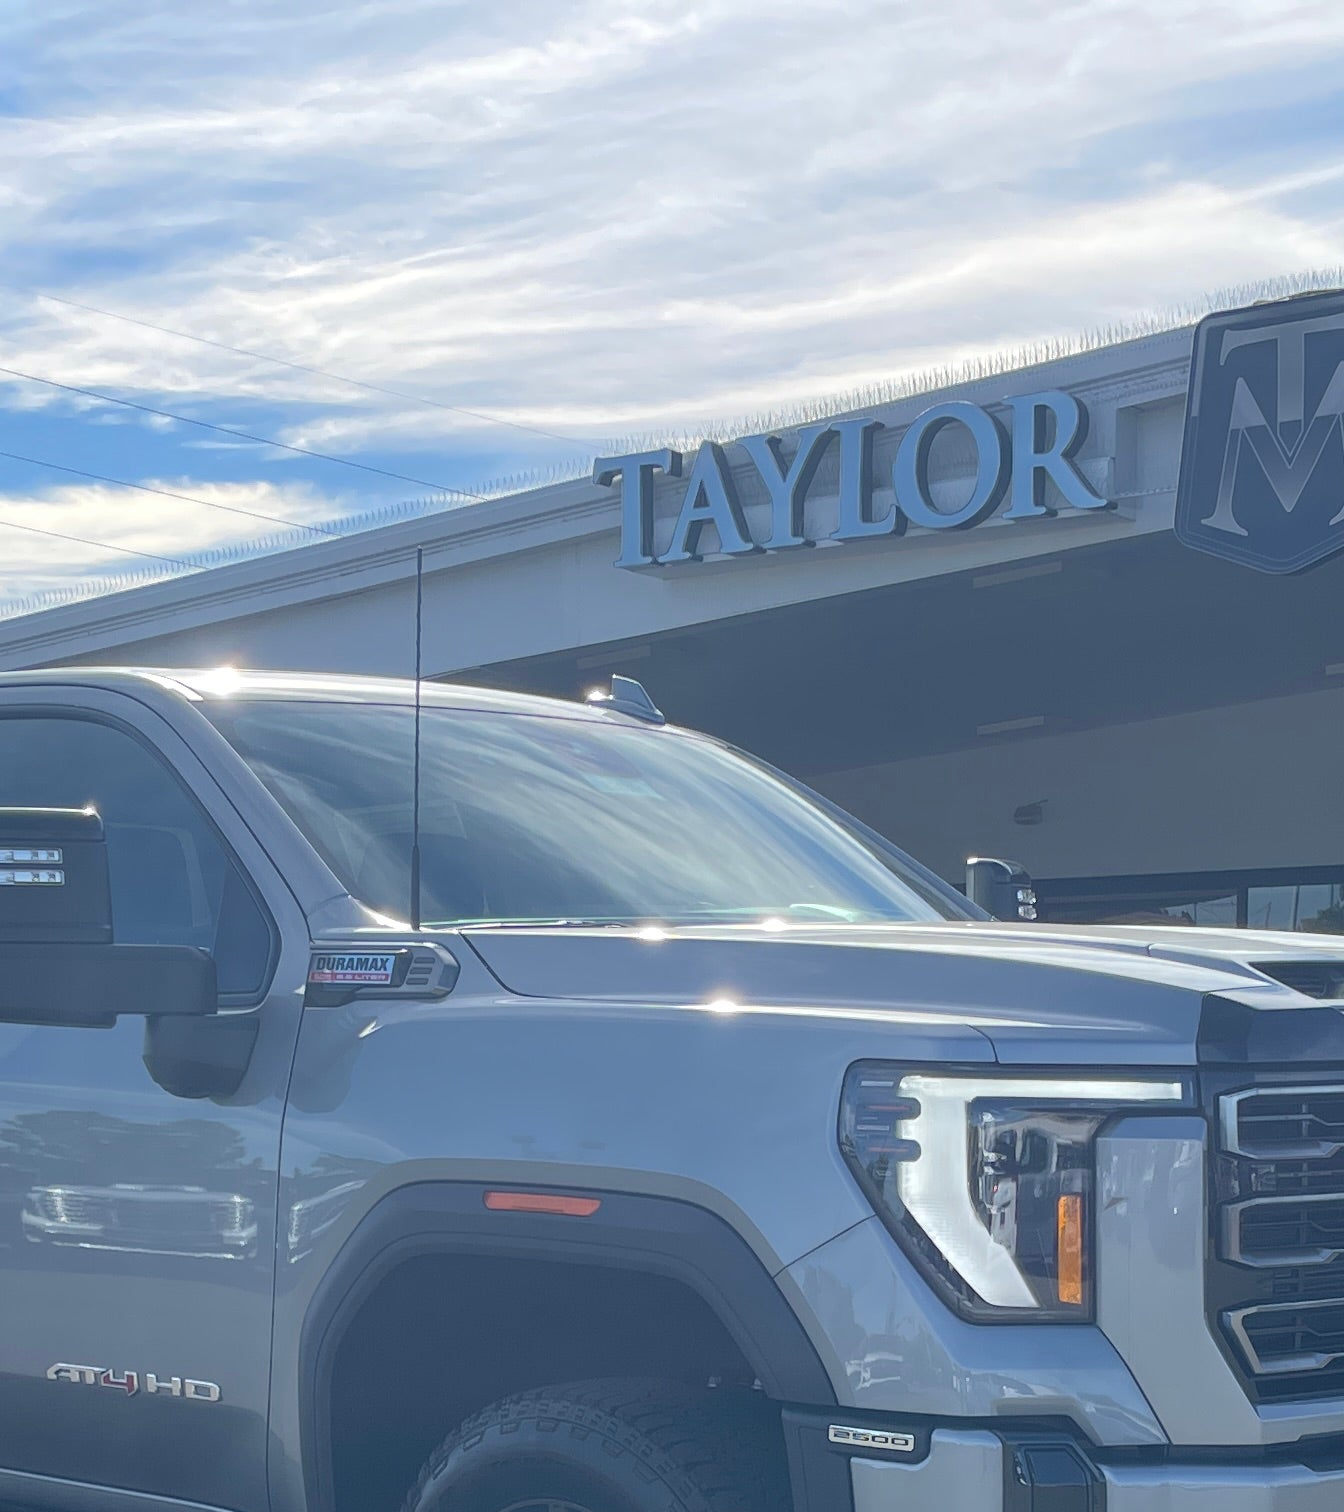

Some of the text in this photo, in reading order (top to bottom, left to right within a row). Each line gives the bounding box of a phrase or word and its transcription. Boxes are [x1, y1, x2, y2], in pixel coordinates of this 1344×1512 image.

[593, 391, 1116, 568] TAYLOR
[316, 956, 390, 972] DURAMAX
[46, 1362, 220, 1401] AT4 HD
[833, 1429, 909, 1447] 2500
